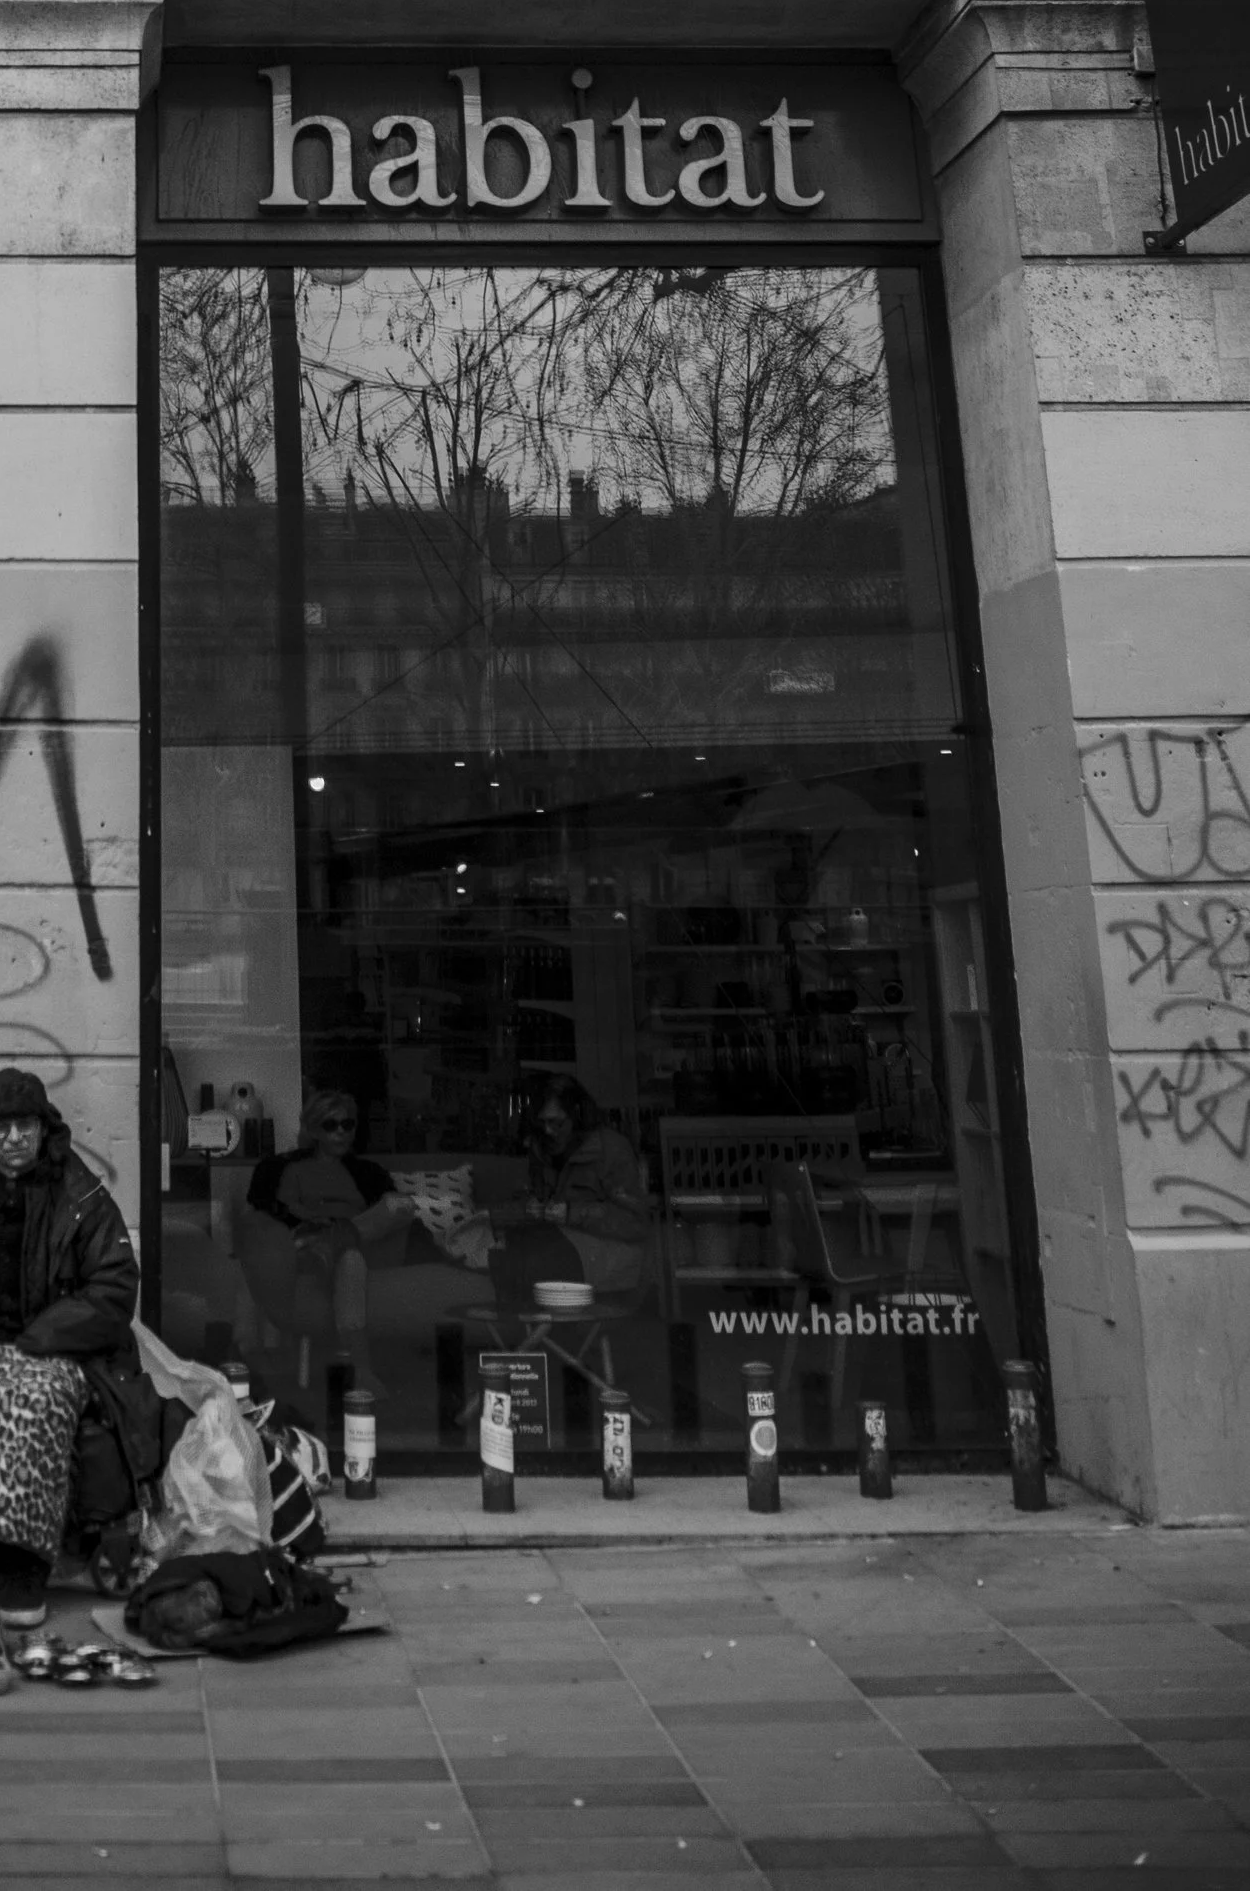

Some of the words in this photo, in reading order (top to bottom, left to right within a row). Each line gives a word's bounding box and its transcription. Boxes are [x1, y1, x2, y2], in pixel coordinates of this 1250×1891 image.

[258, 65, 825, 210] habitat
[1175, 84, 1250, 186] habit
[708, 1304, 980, 1336] www.habitat.fr
